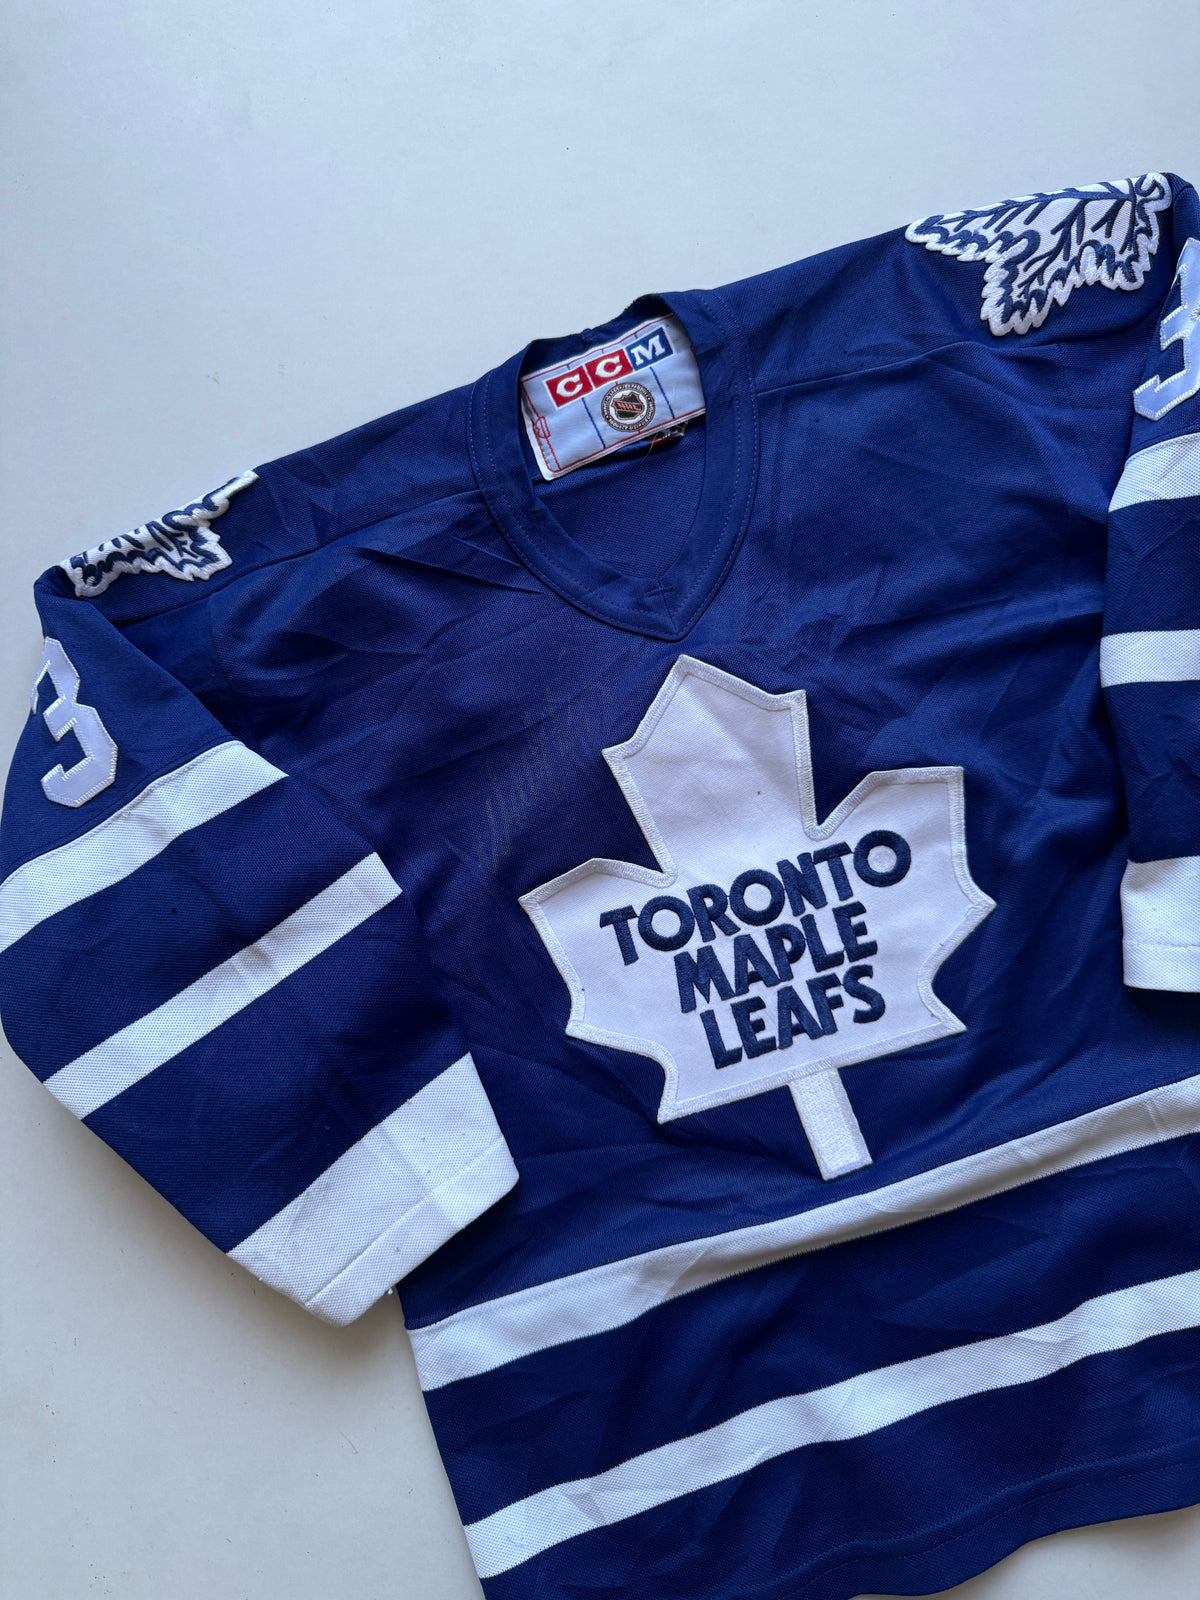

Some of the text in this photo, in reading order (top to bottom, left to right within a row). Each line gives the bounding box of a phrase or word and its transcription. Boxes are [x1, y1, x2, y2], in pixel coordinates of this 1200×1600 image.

[556, 334, 666, 398] CCM
[31, 636, 118, 808] 3
[599, 829, 912, 966] TORONTO
[673, 901, 878, 1014] MAPLE
[699, 964, 886, 1070] LEAFS
